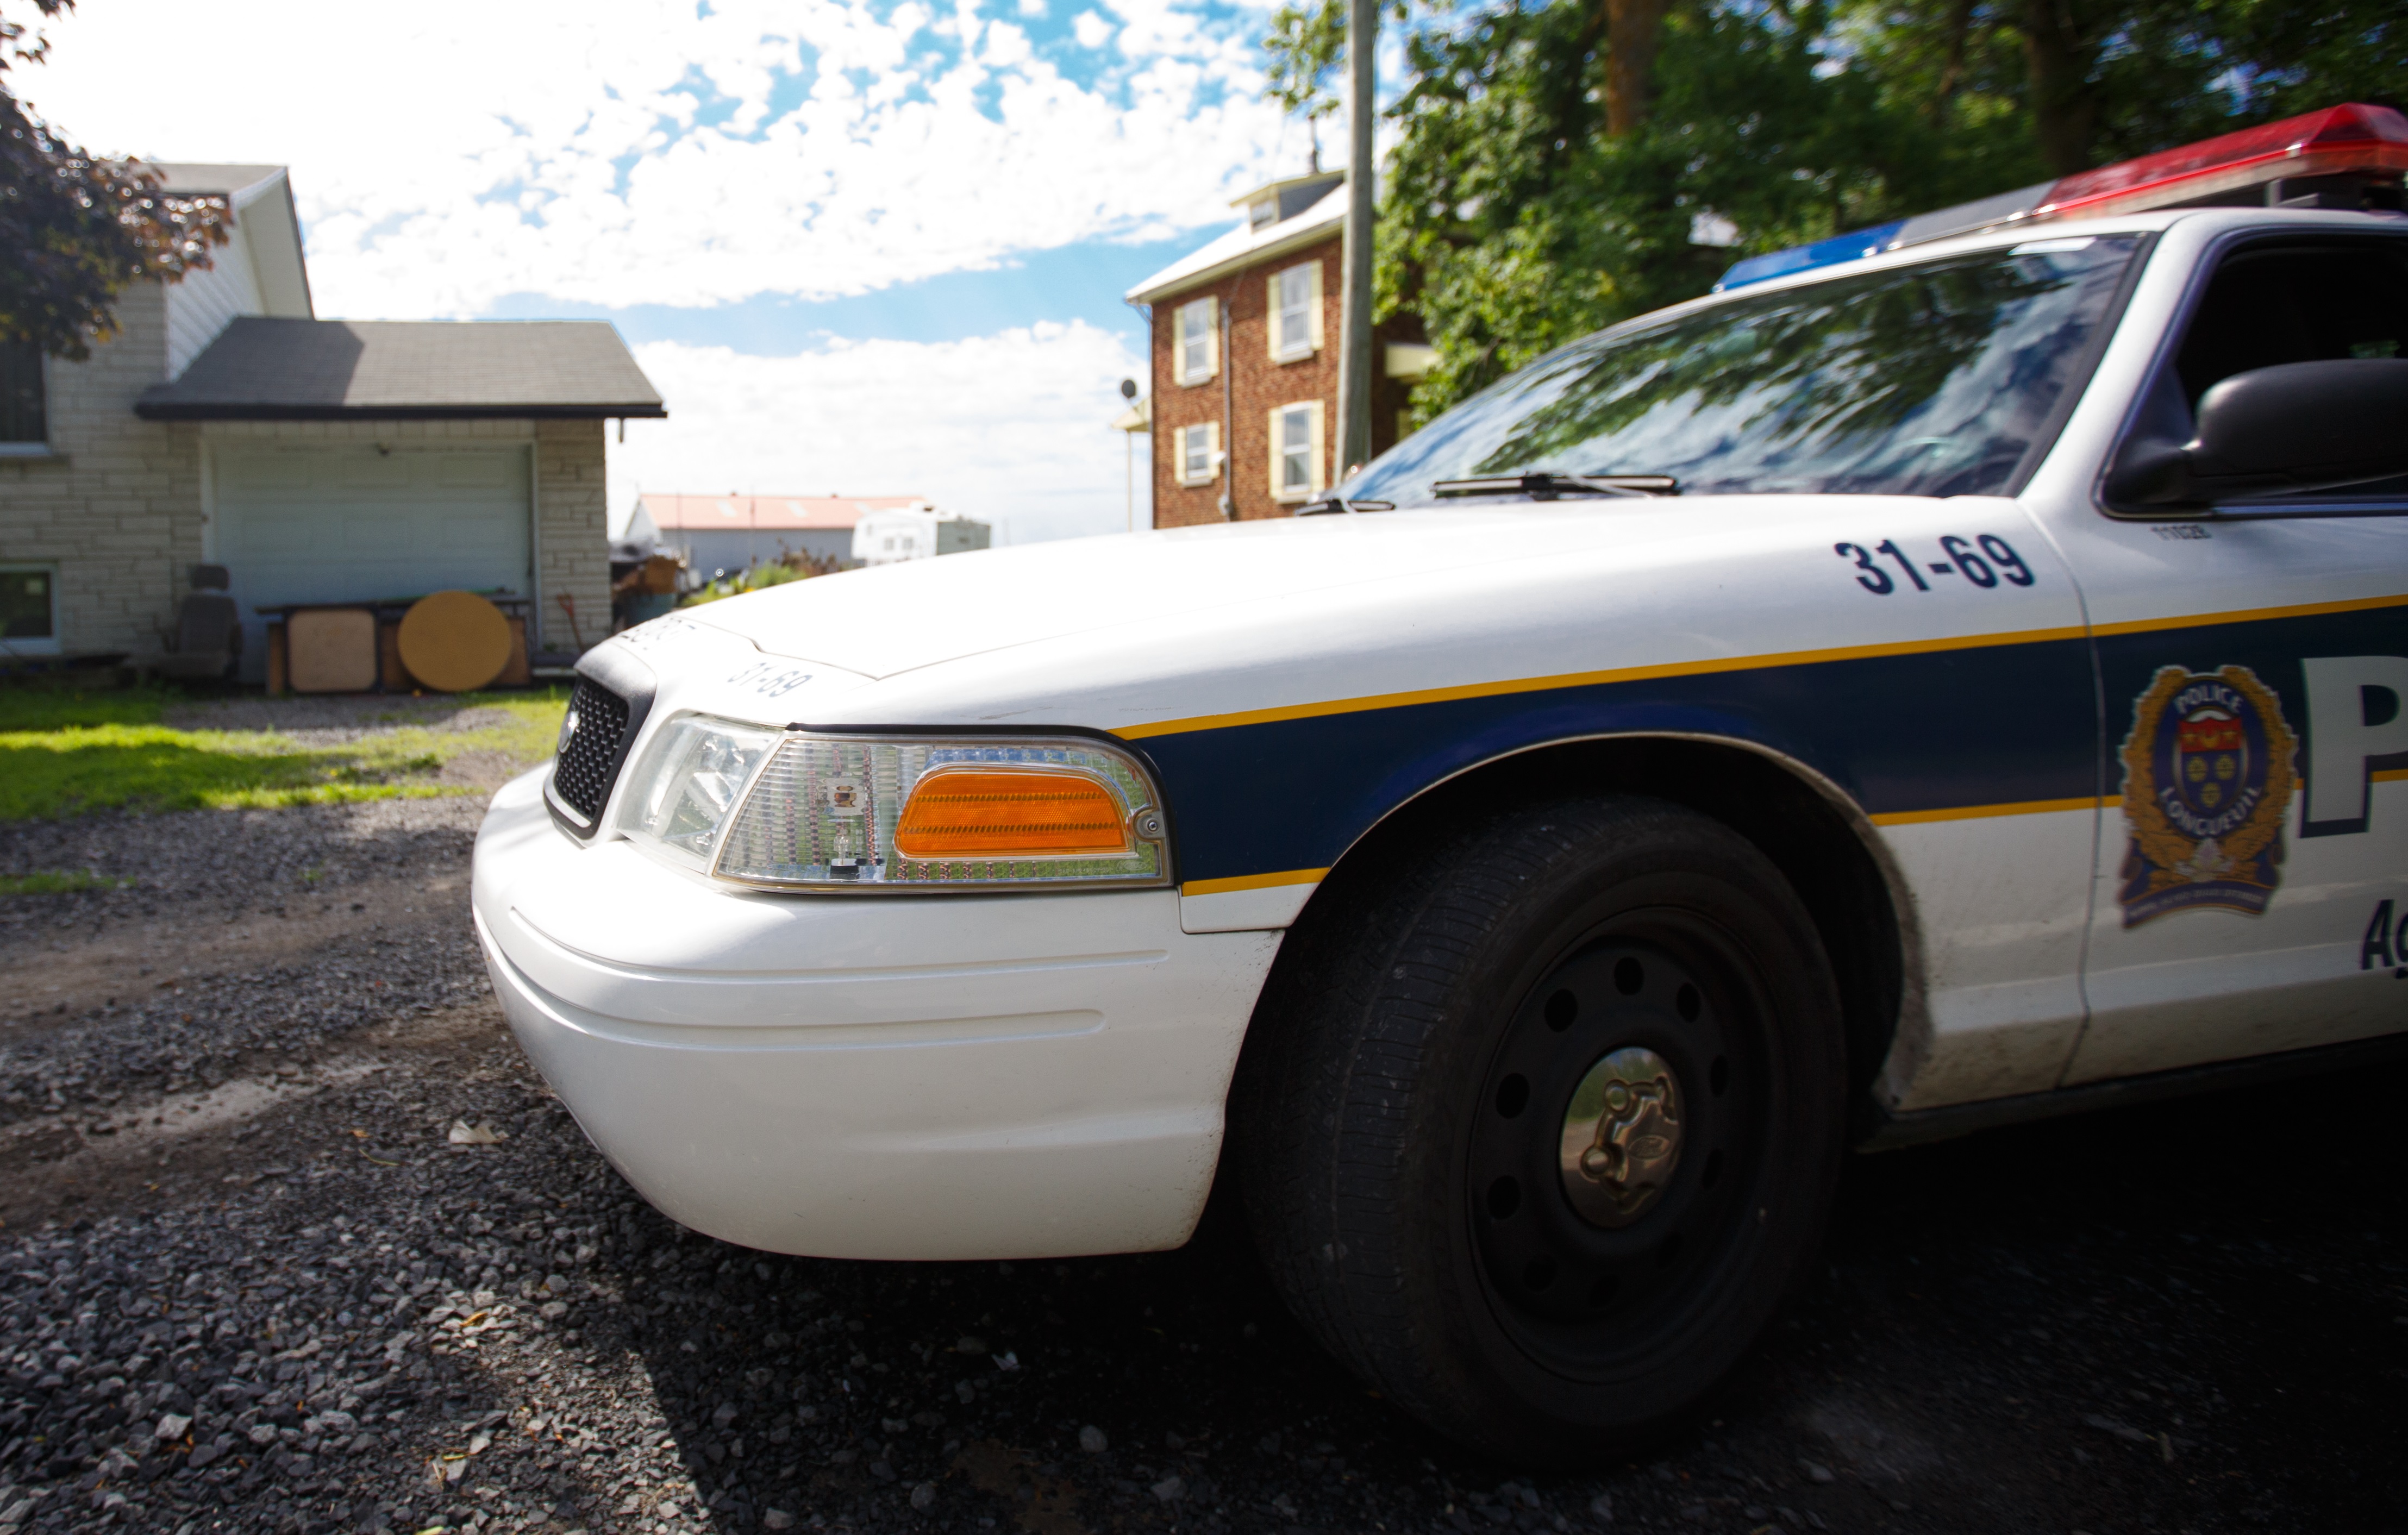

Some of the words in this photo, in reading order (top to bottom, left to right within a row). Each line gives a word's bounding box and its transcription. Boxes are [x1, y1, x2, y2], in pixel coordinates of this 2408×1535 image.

[1834, 534, 2034, 594] 31-69
[727, 662, 814, 697] 31-69
[2173, 684, 2244, 715] POLICE
[2159, 785, 2263, 836] LONGUEUIL
